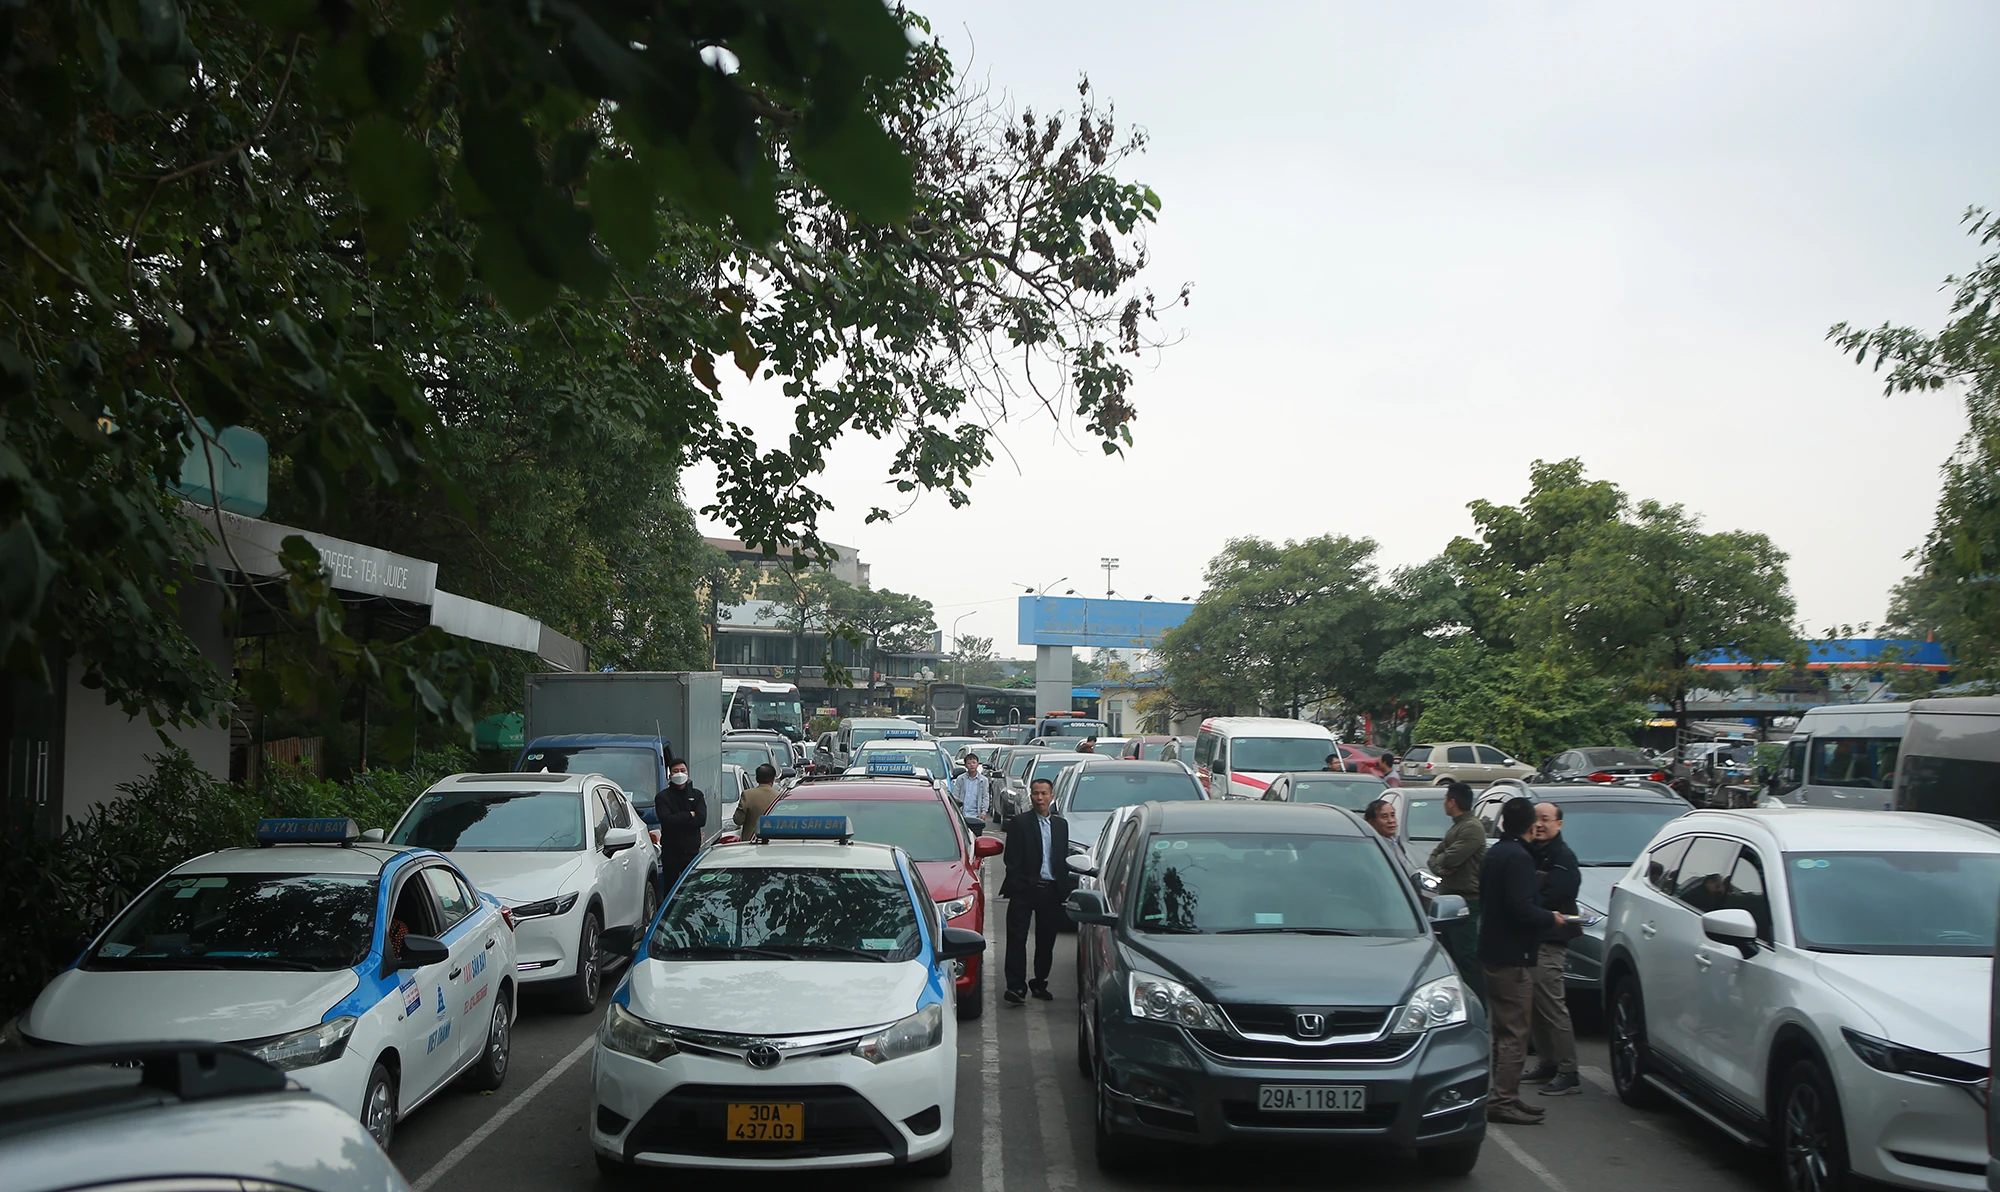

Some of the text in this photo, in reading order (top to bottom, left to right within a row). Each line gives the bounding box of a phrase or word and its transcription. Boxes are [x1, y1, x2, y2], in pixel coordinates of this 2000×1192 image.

[361, 559, 377, 583] TEA
[383, 565, 408, 589] JUICE
[273, 822, 299, 833] TAXI
[324, 822, 346, 833] BAY
[775, 819, 799, 829] TAXI
[824, 819, 845, 829] BAY
[1262, 1089, 1363, 1109] 29A-118.12
[749, 1105, 781, 1121] 30A
[735, 1123, 795, 1140] 437.03
